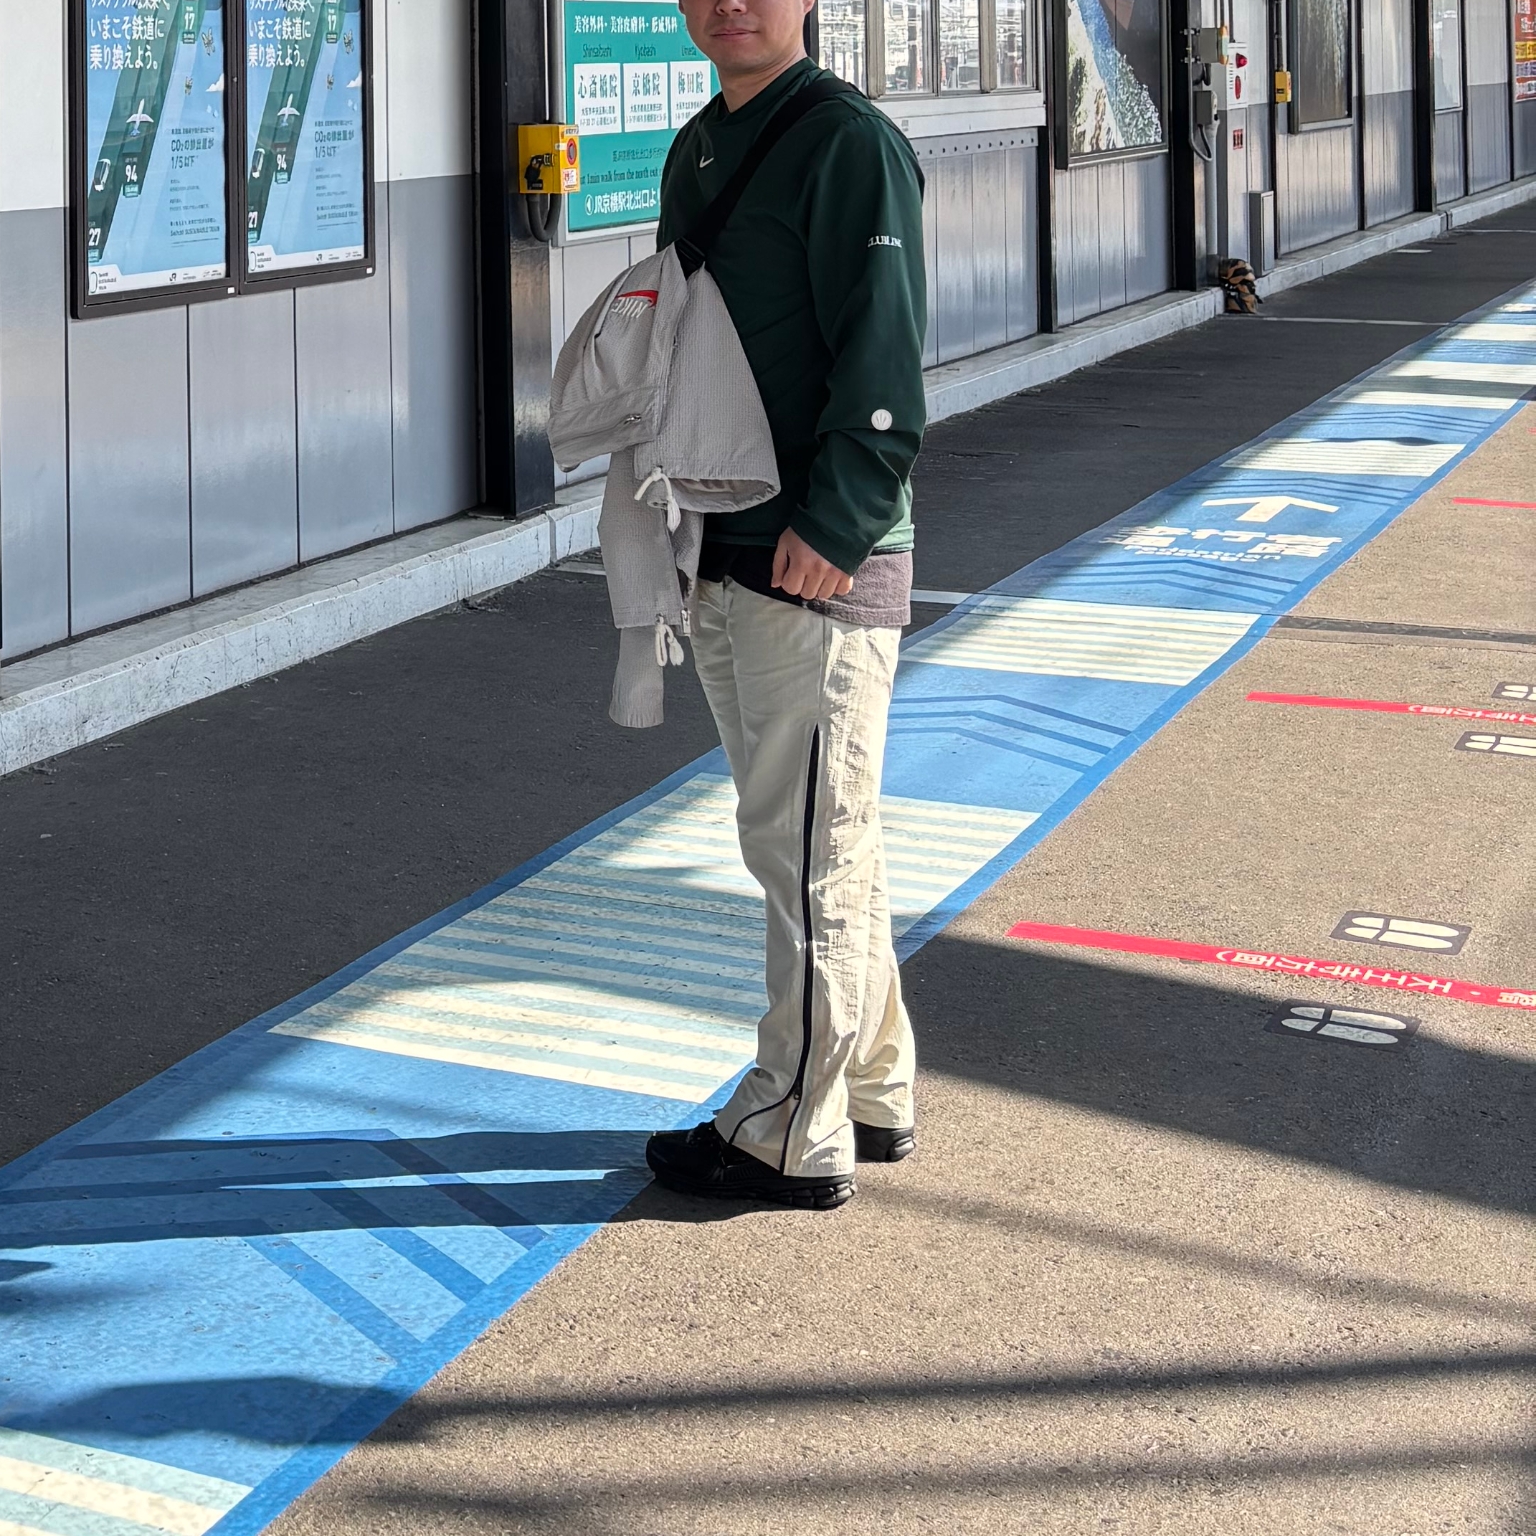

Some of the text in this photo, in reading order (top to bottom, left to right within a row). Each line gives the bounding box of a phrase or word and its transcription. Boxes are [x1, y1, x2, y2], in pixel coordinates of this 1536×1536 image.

[90, 15, 164, 40] いまこそ鉄道に
[184, 13, 195, 30] 17
[249, 17, 311, 40] いまこそ鉄道に
[328, 15, 337, 31] 17
[90, 44, 158, 69] 乗り換えよう。
[248, 44, 305, 67] 乗り換えよう。
[632, 72, 661, 97] 京橋院
[276, 154, 287, 170] 94
[125, 165, 138, 182] 94
[88, 228, 100, 246] 27
[611, 296, 648, 318] NIKE
